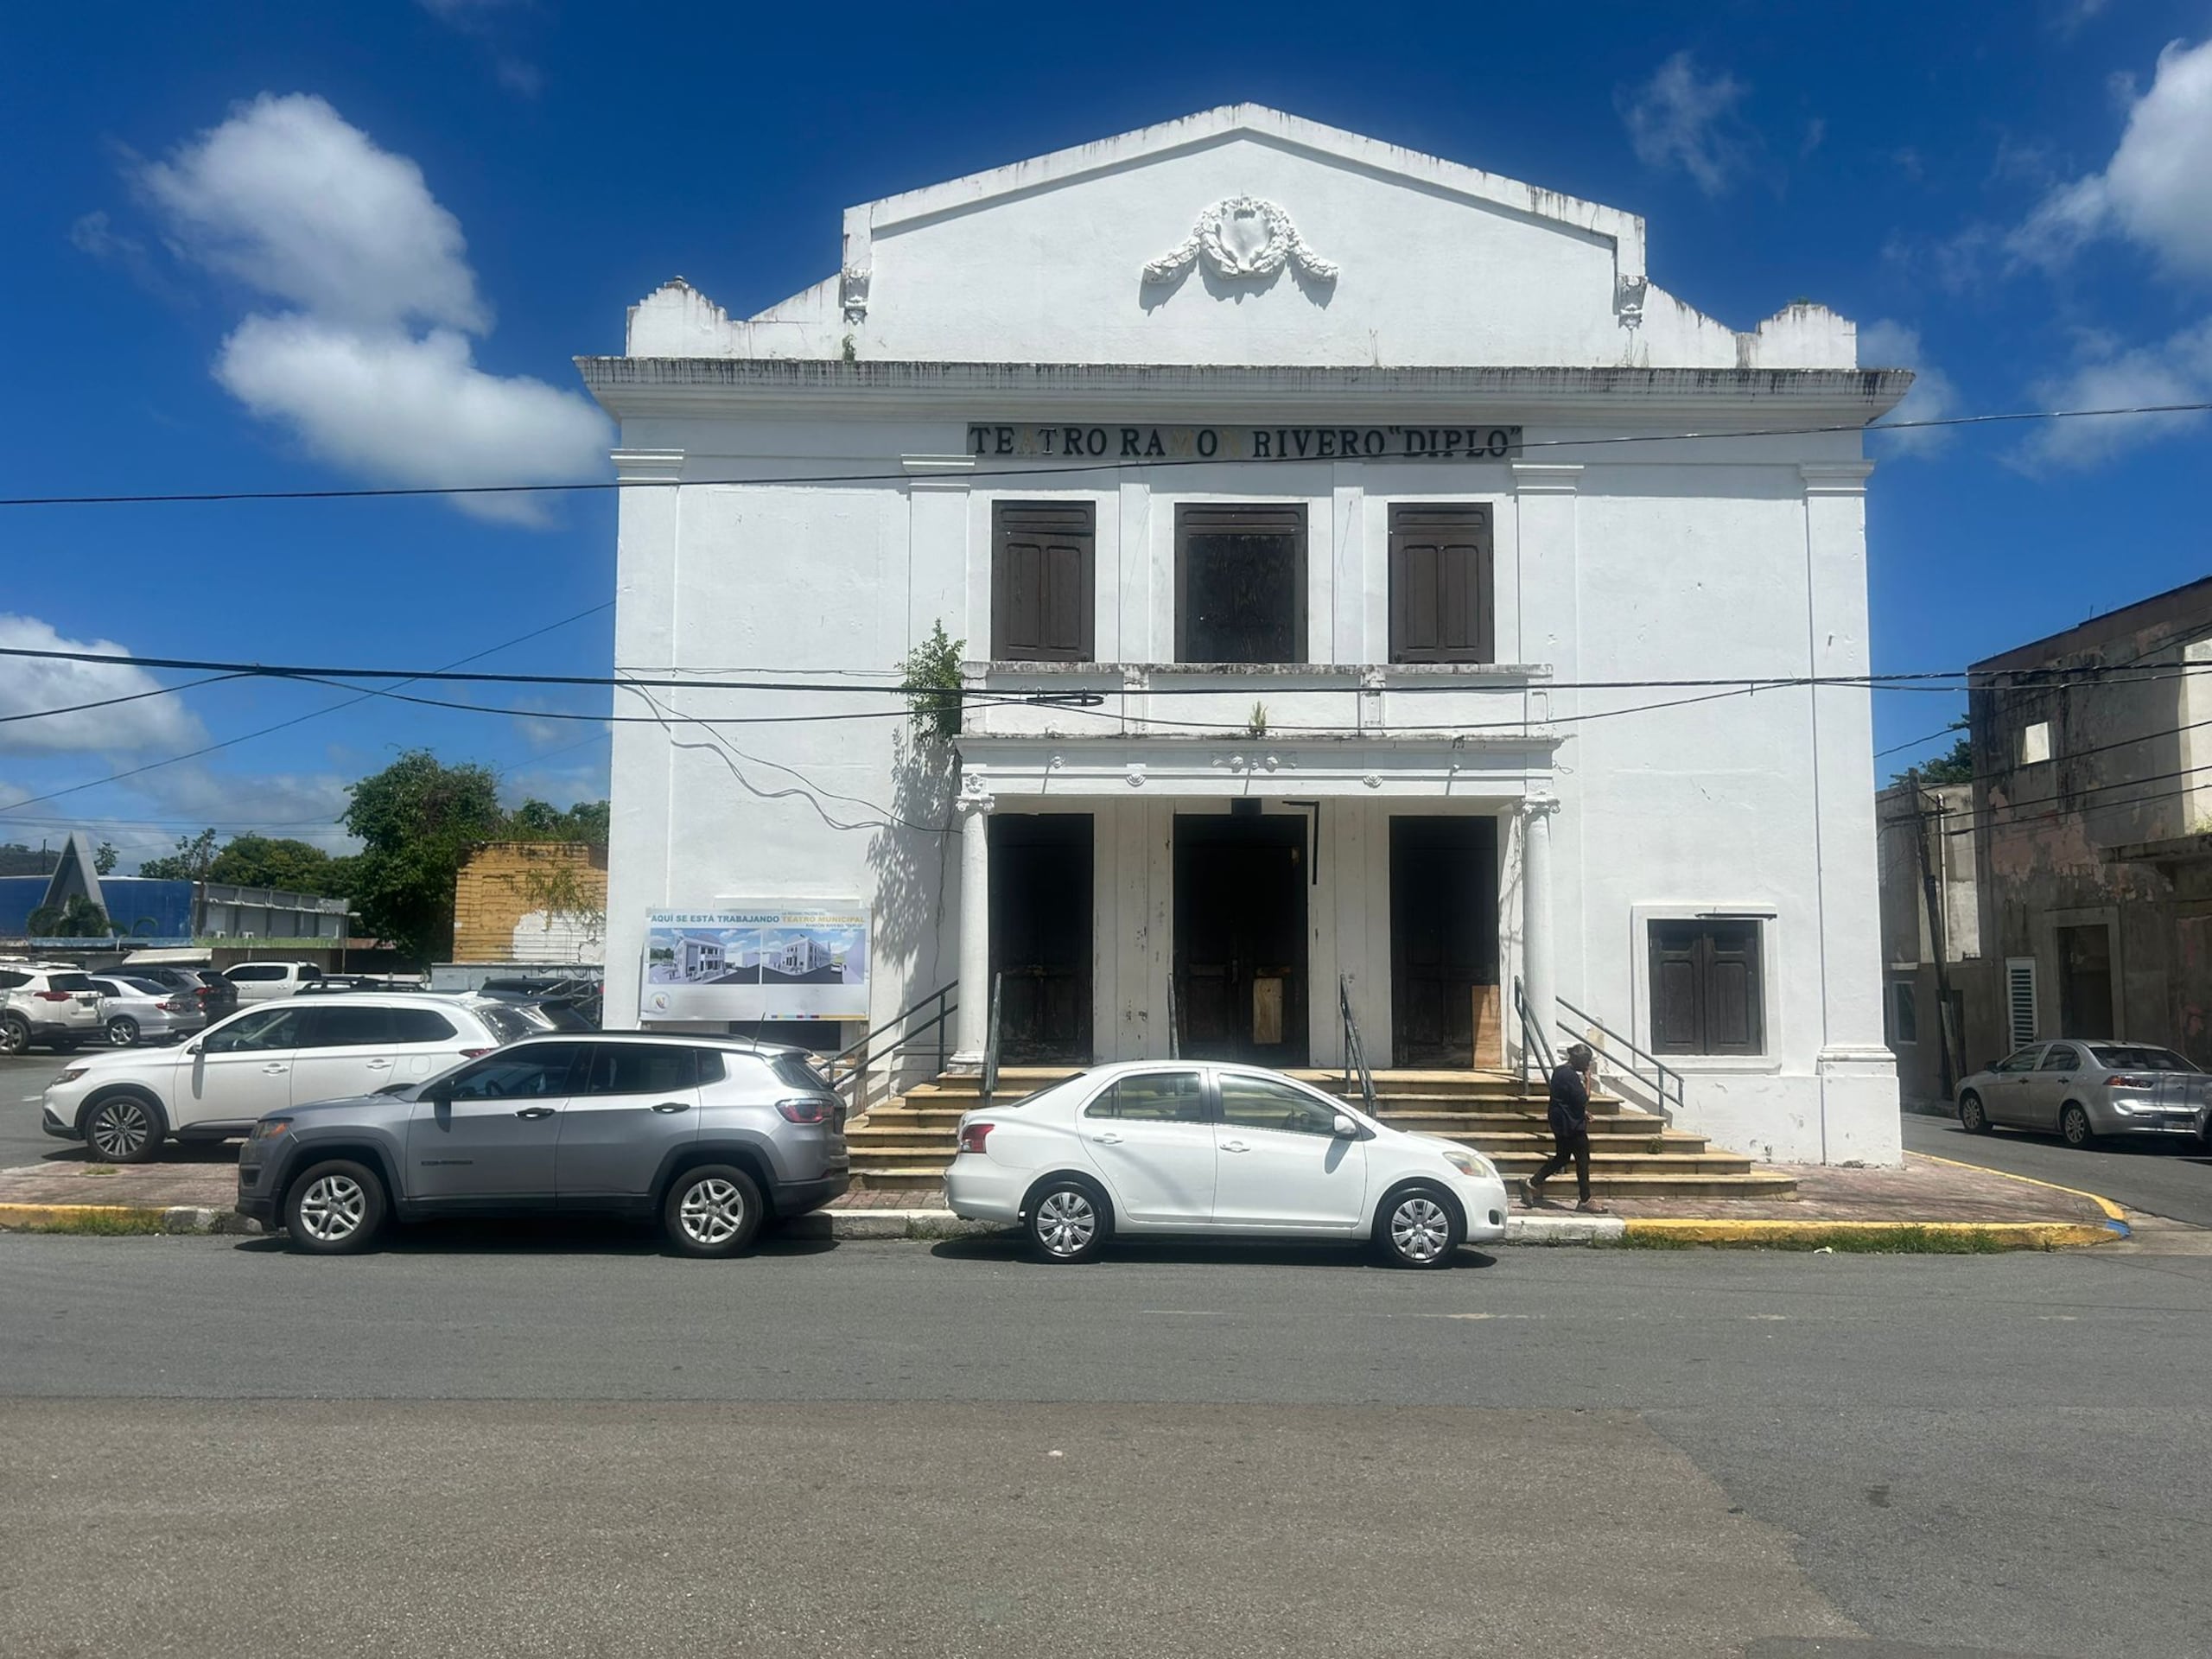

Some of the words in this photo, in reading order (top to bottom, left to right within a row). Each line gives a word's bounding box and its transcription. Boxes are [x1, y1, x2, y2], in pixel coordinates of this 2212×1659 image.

[1253, 429, 1386, 458] RIVERO
[652, 913, 673, 923] AQUÍ
[690, 913, 715, 923] ESTÁ
